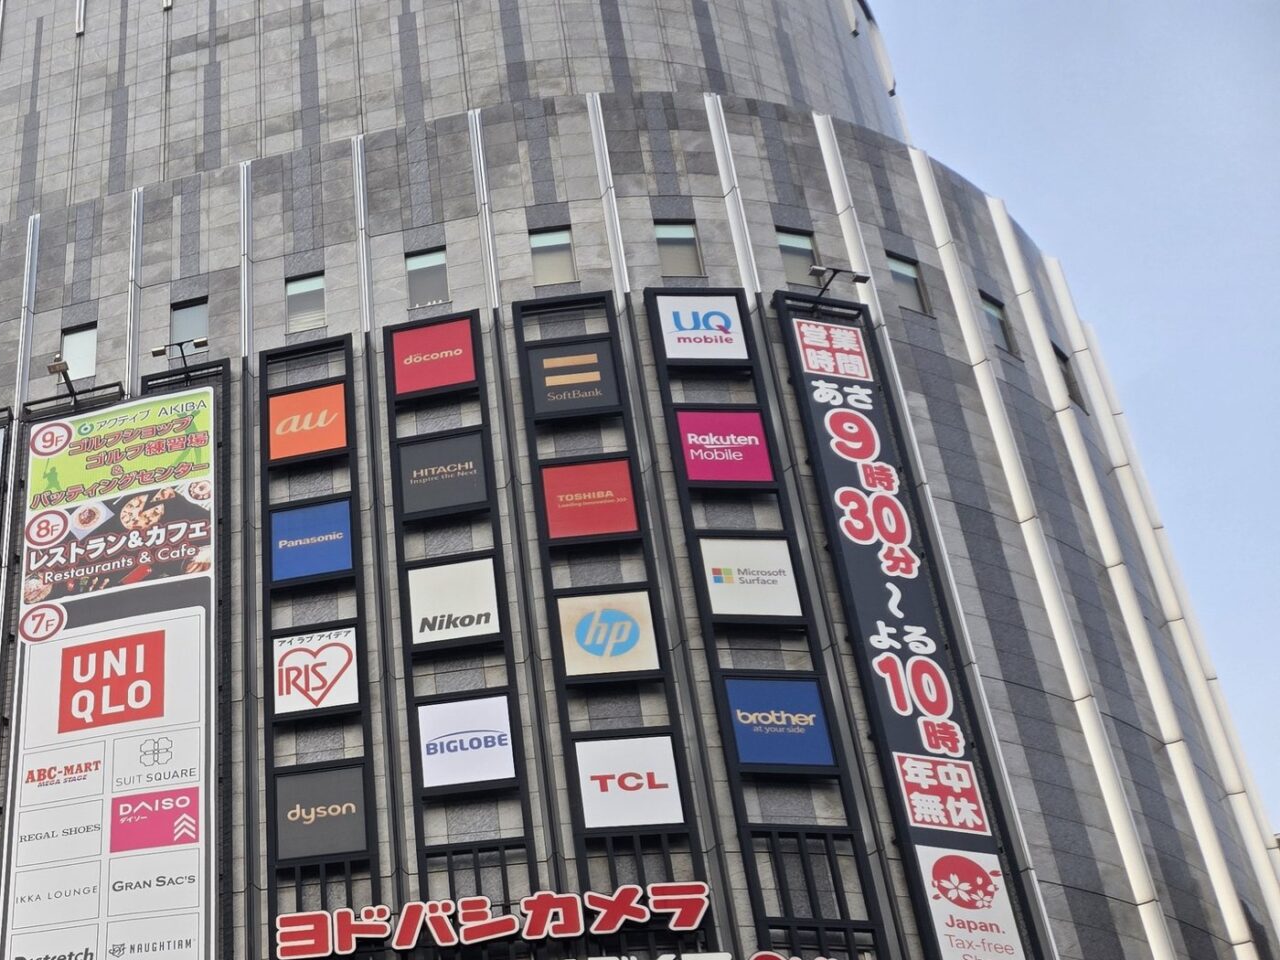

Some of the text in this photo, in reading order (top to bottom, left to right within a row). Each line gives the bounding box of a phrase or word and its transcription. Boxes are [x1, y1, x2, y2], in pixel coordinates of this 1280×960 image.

[672, 311, 733, 335] UQ
[677, 334, 734, 344] mobile
[800, 323, 861, 352] 営業
[403, 347, 463, 365] docomo
[807, 349, 868, 378] 時間
[547, 388, 603, 401] SoftBank
[811, 380, 873, 410] あさ
[97, 399, 207, 431] アクティブ AKIBA
[275, 408, 338, 436] au
[42, 431, 64, 449] 9F
[68, 415, 194, 456] ゴルフショップ
[687, 432, 759, 446] Rakuten
[85, 431, 209, 471] ゴルフ練習場
[690, 447, 743, 461] Mobile
[111, 465, 124, 476] &
[412, 461, 474, 478] HITACHI
[30, 462, 209, 510] バッティングセンター
[557, 490, 614, 502] TOSHIBA
[36, 519, 60, 538] 8F
[29, 521, 209, 571] レストラン&カフェ
[278, 531, 344, 549] Panasonic
[44, 544, 196, 584] Restaurants & Cafe
[737, 567, 787, 578] Microsoft
[738, 576, 779, 586] Surface
[31, 613, 55, 634] 7F
[419, 611, 491, 633] Nikon
[584, 608, 632, 657] hp
[870, 620, 937, 654] よる
[72, 644, 145, 684] UNI
[278, 662, 328, 697] IRIS
[71, 679, 152, 723] QLO
[735, 709, 816, 727] brother
[753, 725, 806, 737] at your side
[425, 733, 509, 755] BIGLOBE
[25, 760, 101, 784] ABC-MART
[37, 774, 88, 788] MEGA STAGE
[115, 767, 197, 787] SUIT SQUARE
[590, 771, 669, 793] TCL
[902, 758, 972, 792] 年中
[119, 795, 191, 816] DAISO
[287, 802, 356, 825] dyson
[911, 791, 982, 828] 無休
[119, 814, 148, 824] ダイソー
[19, 823, 101, 843] REGAL SHOES
[15, 885, 98, 905] IKKA LOUNGE
[276, 881, 711, 960] ヨドバシカメラ
[944, 914, 1006, 935] Japan.
[129, 938, 192, 954] NAUGHTIAM
[943, 933, 1015, 956] Tax-free
